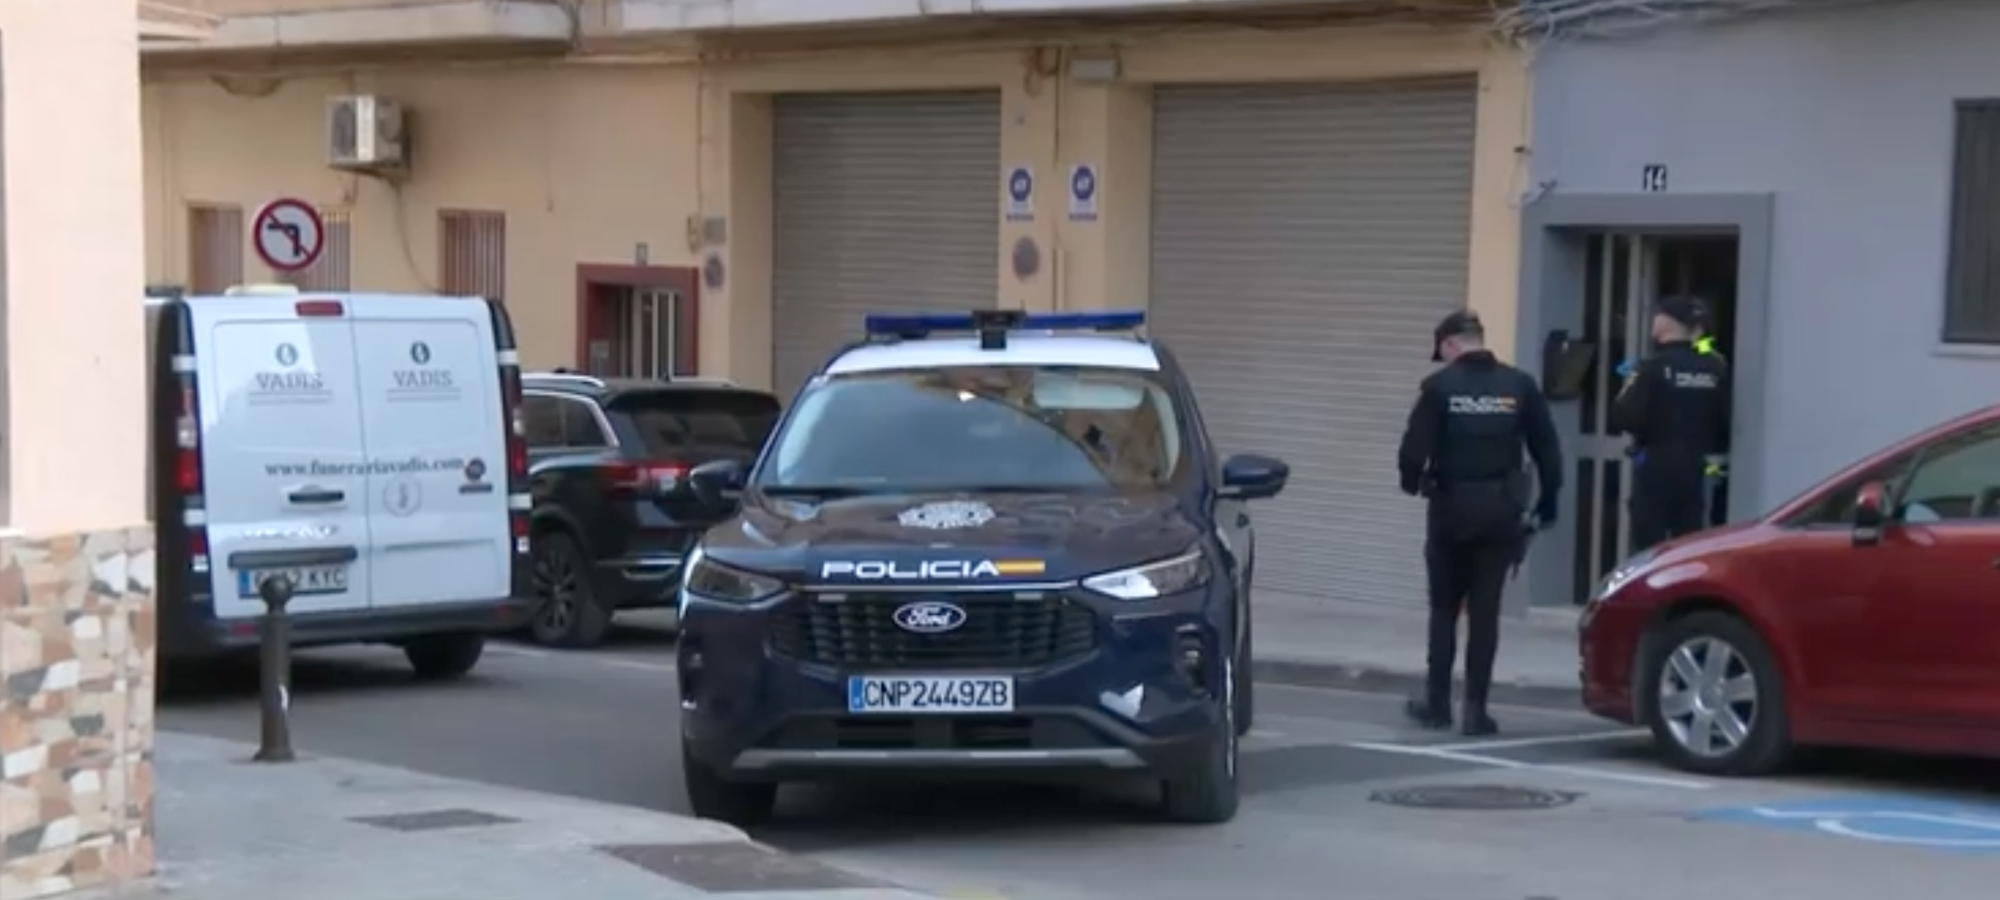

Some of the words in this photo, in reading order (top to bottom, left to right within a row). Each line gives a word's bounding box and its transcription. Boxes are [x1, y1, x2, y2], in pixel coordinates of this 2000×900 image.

[1646, 167, 1666, 190] 14
[256, 372, 324, 390] VADIS
[393, 370, 454, 387] VADIS
[264, 457, 466, 476] www.funerariavadis.com
[308, 567, 347, 587] KYC
[821, 559, 1000, 579] POLICIA
[906, 605, 951, 626] Ford
[864, 680, 1008, 707] CNP2449ZB
